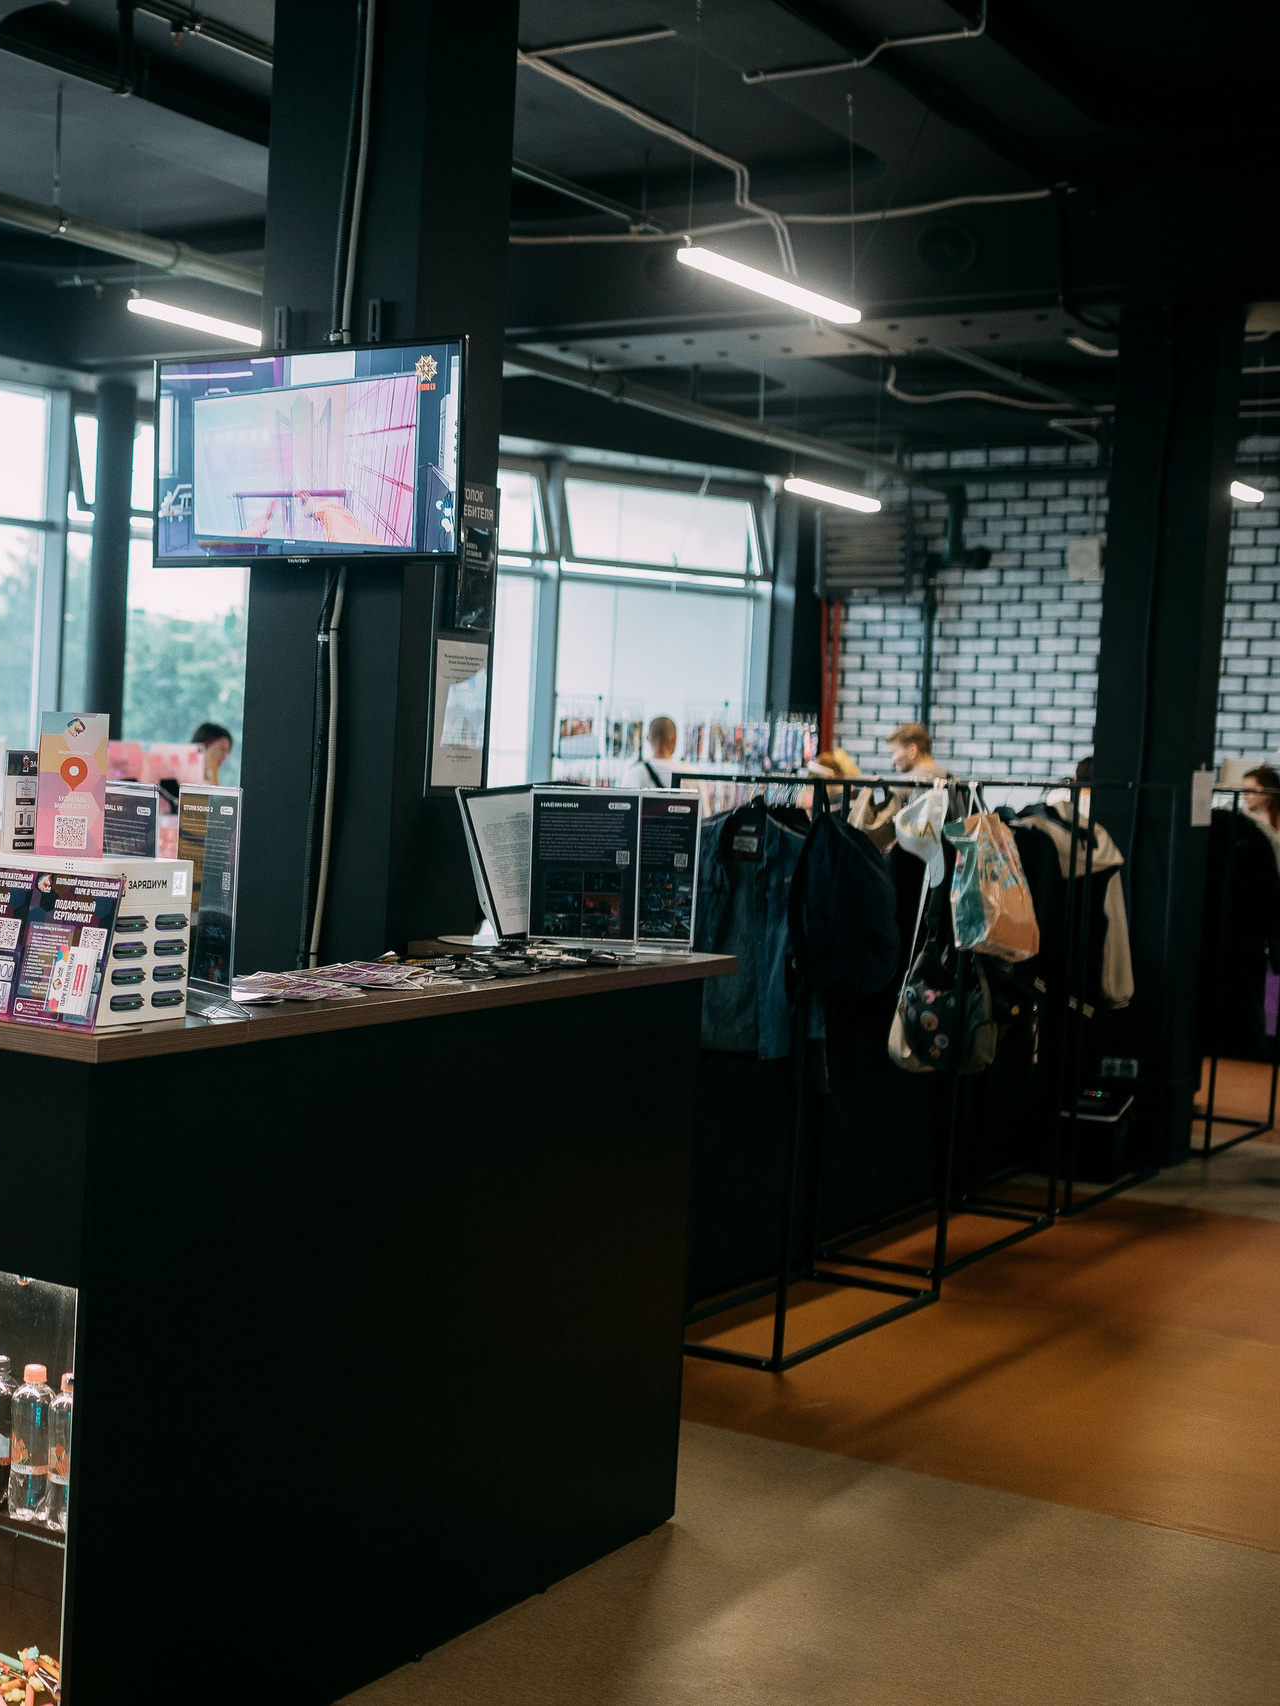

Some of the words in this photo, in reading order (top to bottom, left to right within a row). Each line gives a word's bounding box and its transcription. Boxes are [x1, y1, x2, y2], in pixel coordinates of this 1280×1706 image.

[128, 880, 167, 889] ЗАРЯДИУМ
[54, 899, 96, 912] ПОДАРОЧНЫЙ
[53, 911, 93, 923] СЕРТИФИКАТ
